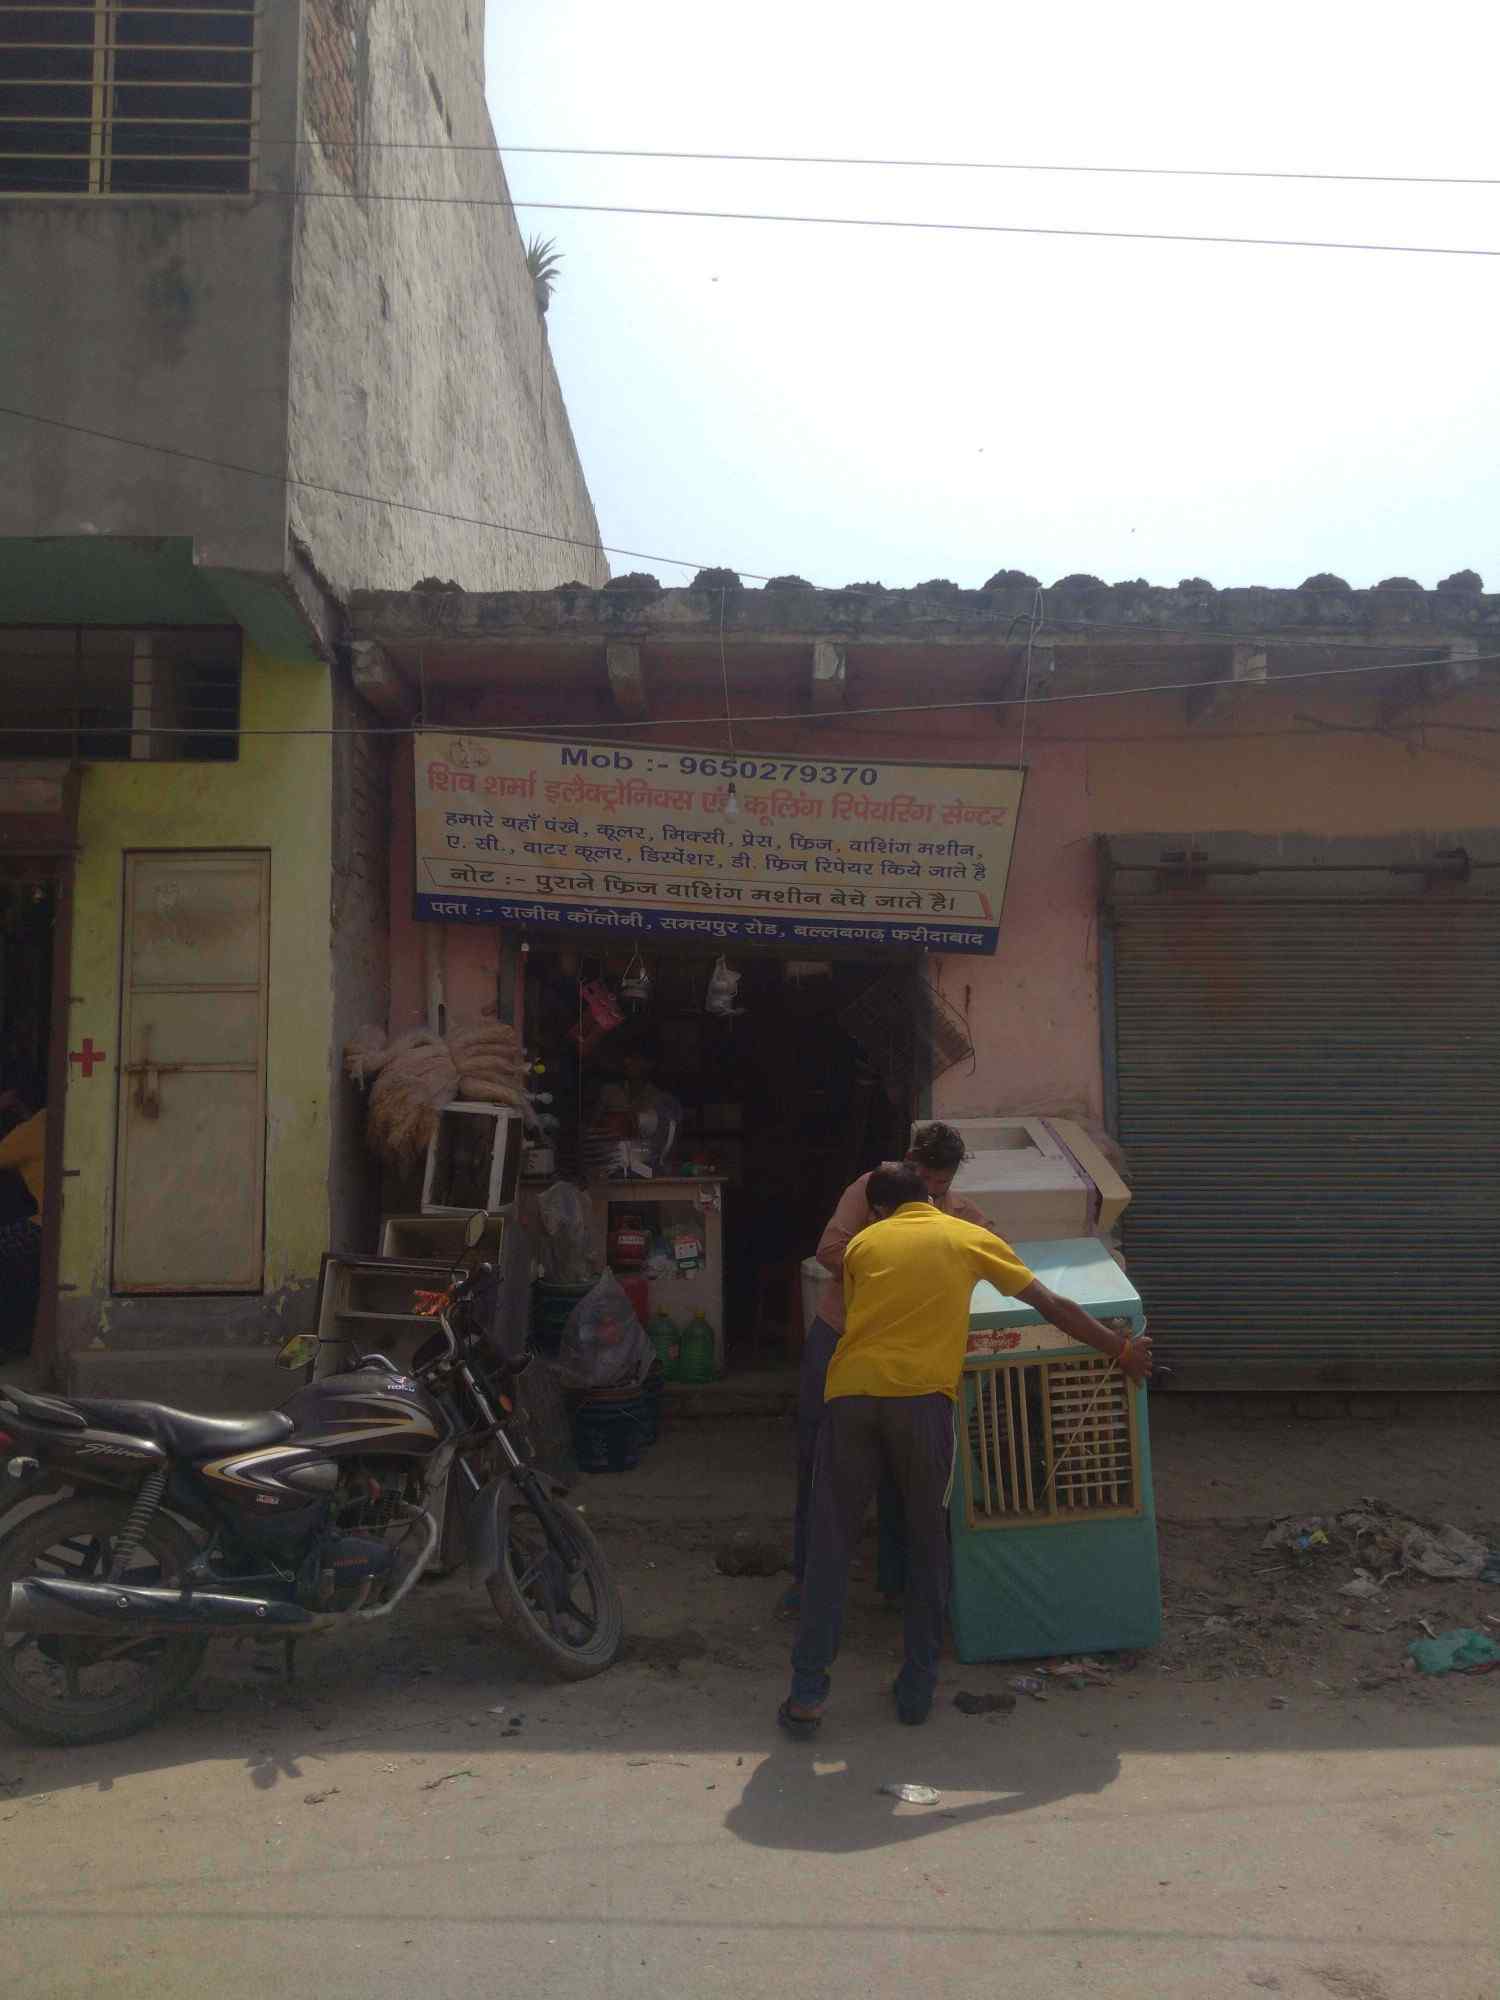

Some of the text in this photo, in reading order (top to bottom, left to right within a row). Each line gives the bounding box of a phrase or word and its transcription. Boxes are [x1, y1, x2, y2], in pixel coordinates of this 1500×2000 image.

[561, 747, 633, 770] Mob
[679, 756, 879, 786] 9650279370
[427, 760, 476, 793] शिव
[485, 767, 537, 800] शर्मा
[744, 786, 824, 827] कूलिंग
[942, 797, 1008, 826] सेन्टर
[445, 807, 495, 828] हमारे
[501, 813, 541, 832] यहाँ
[544, 816, 589, 838] पंखे,
[597, 822, 654, 843] कूलर,
[662, 824, 734, 848] मिक्सी,
[741, 829, 782, 850] प्रेस,
[848, 836, 913, 855] वाशिंग
[918, 838, 984, 859] मशीन,
[523, 841, 568, 857] वाटर
[575, 843, 632, 863] कूलर,
[880, 859, 921, 878] किये
[928, 862, 967, 879] जाते
[449, 863, 496, 883] नोट
[535, 872, 594, 894] पुराने
[665, 879, 744, 901] वाशिंग
[750, 885, 822, 906] मशीन
[830, 888, 867, 908] बेचे
[874, 891, 923, 910] जाते
[430, 899, 469, 916] पता
[499, 904, 561, 922] राजीव
[566, 906, 652, 931] कॉलोनी,
[659, 916, 740, 937] समयपुर
[743, 918, 786, 938] रोड,
[891, 925, 985, 946] फरीदाबाद
